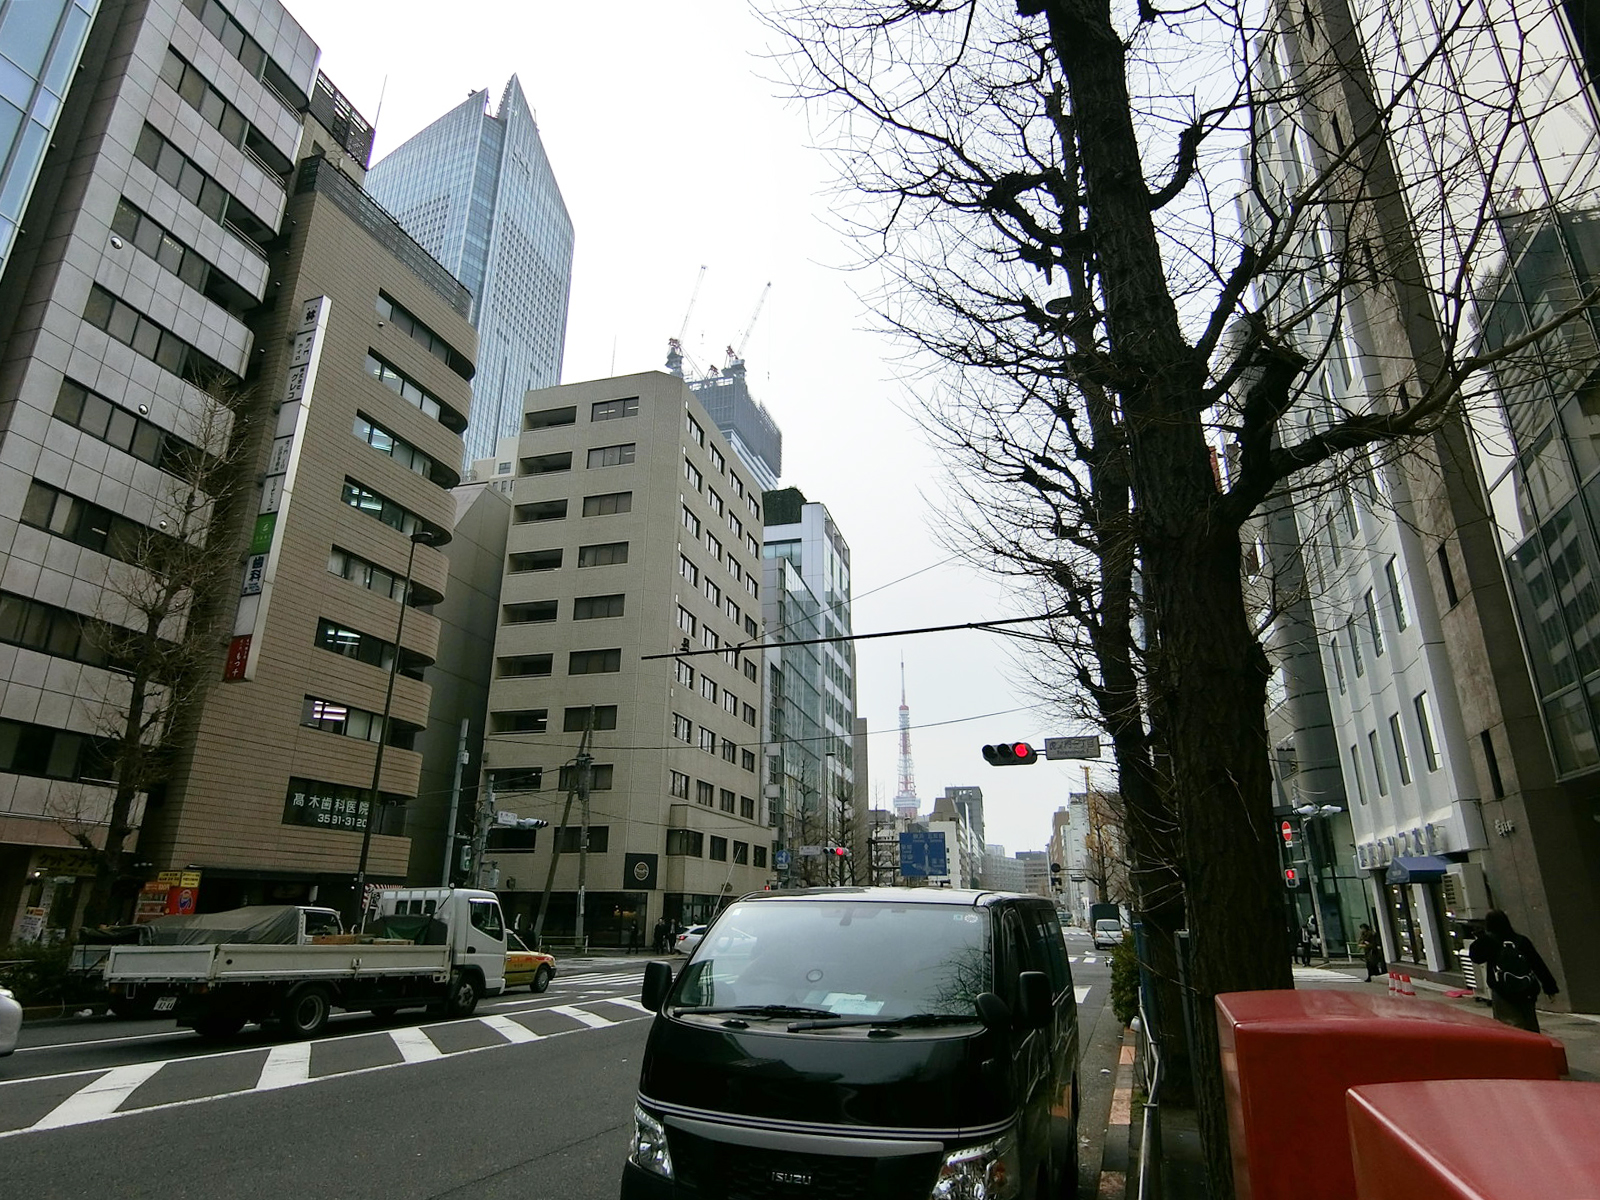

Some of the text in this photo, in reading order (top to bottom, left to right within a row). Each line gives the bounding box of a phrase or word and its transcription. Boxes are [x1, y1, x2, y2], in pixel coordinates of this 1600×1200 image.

[287, 372, 299, 400] グレコ
[771, 1171, 812, 1186] ISUZU
